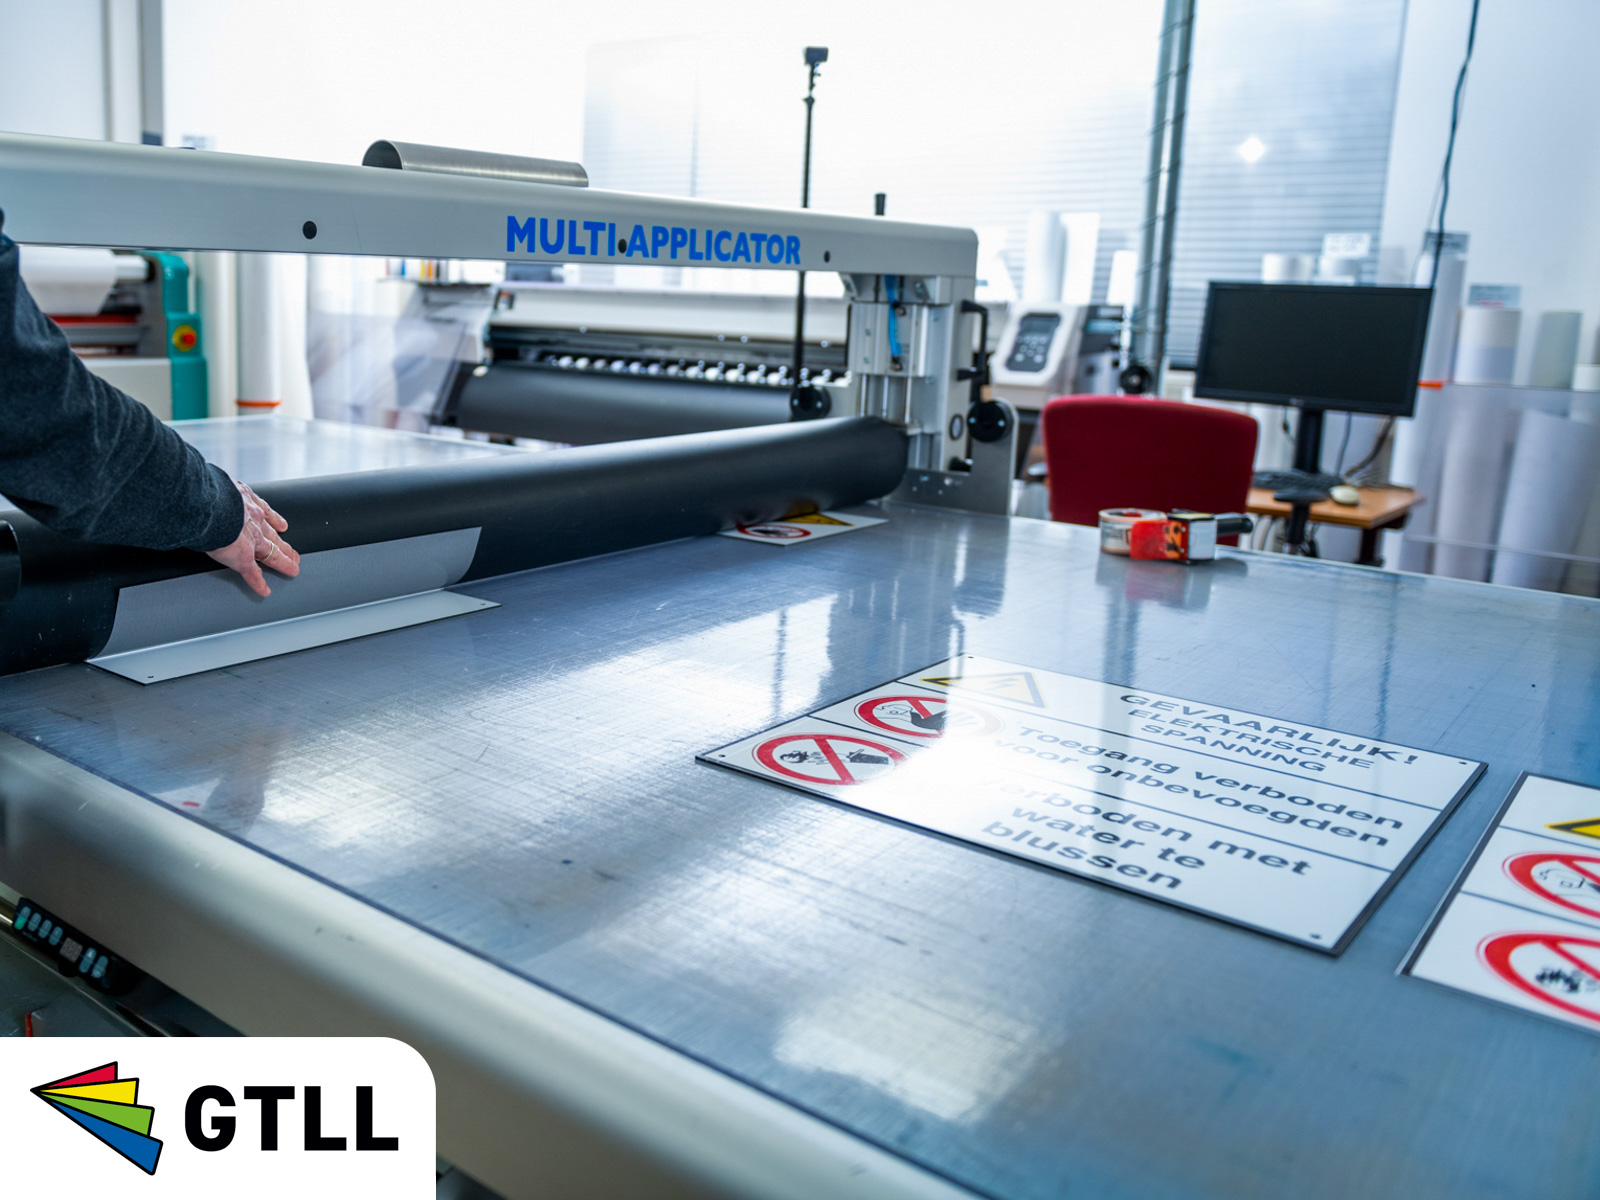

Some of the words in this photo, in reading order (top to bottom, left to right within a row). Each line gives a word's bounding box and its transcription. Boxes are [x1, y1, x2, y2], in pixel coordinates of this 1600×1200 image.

[506, 215, 616, 257] MULTI
[625, 224, 801, 265] APPLICATOR
[1120, 693, 1418, 766] GEVAARLIJK!
[1128, 708, 1375, 770] ELEKTRISCHE
[1140, 723, 1326, 773] SPANNING
[993, 739, 1079, 765] voor
[1086, 763, 1390, 847] onbevoegden
[1018, 725, 1181, 774] Toegang
[1194, 770, 1404, 830] verboden
[980, 820, 1184, 890] blussen
[1010, 807, 1147, 850] water
[1156, 846, 1207, 870] te
[1208, 838, 1313, 876] met
